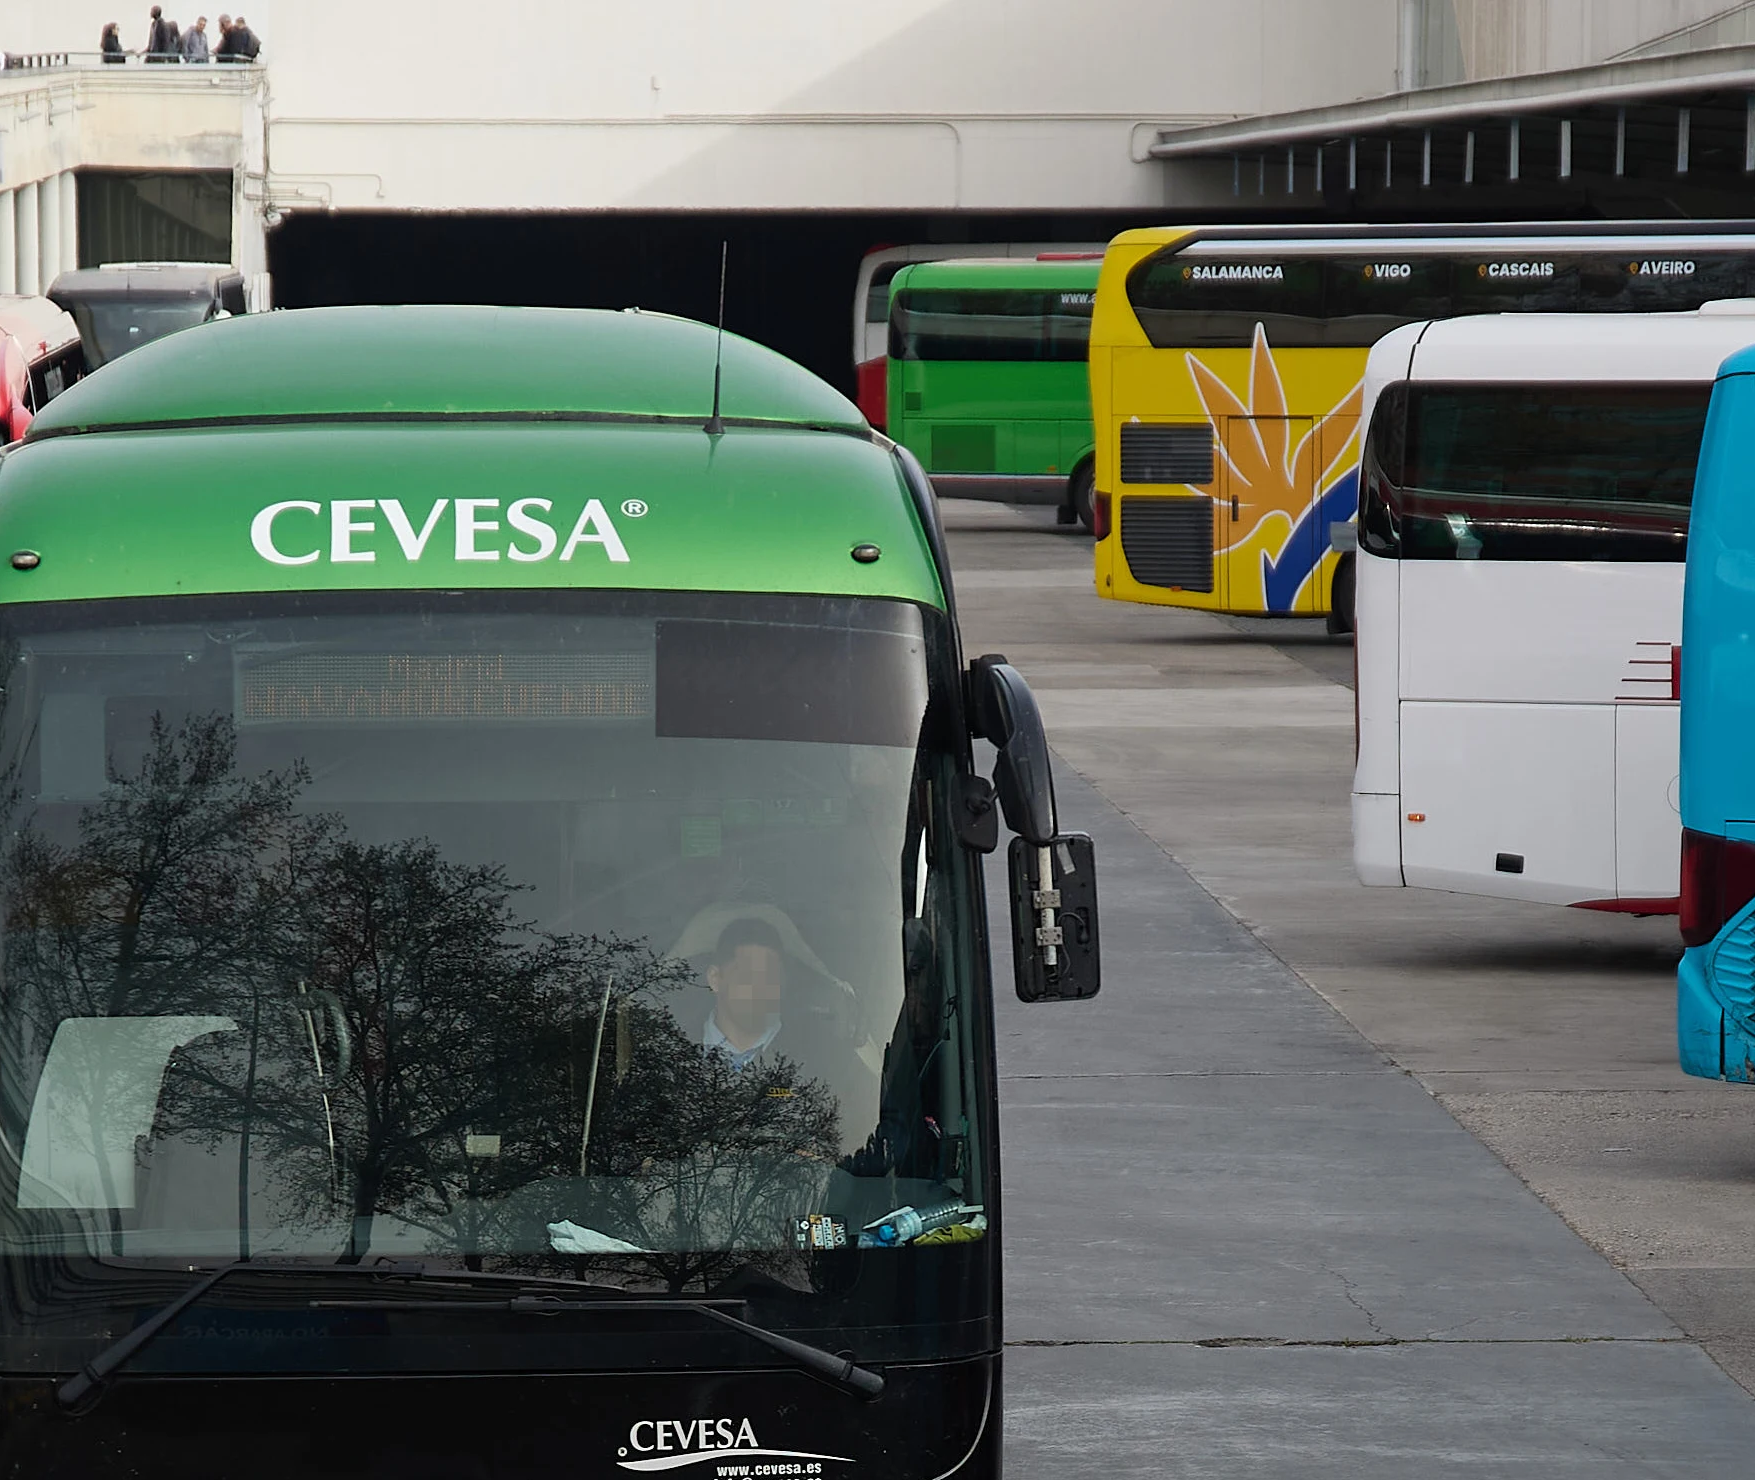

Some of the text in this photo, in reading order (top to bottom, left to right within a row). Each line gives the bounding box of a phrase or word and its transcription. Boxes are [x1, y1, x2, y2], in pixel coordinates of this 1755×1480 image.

[1192, 264, 1284, 281] SALAMANCA
[1374, 263, 1412, 278] VIGO
[1488, 262, 1554, 277] CASCAIS
[1639, 260, 1695, 275] AVEIRO
[629, 1417, 759, 1452] CEVESA
[716, 1462, 822, 1478] www.cevesa.es
